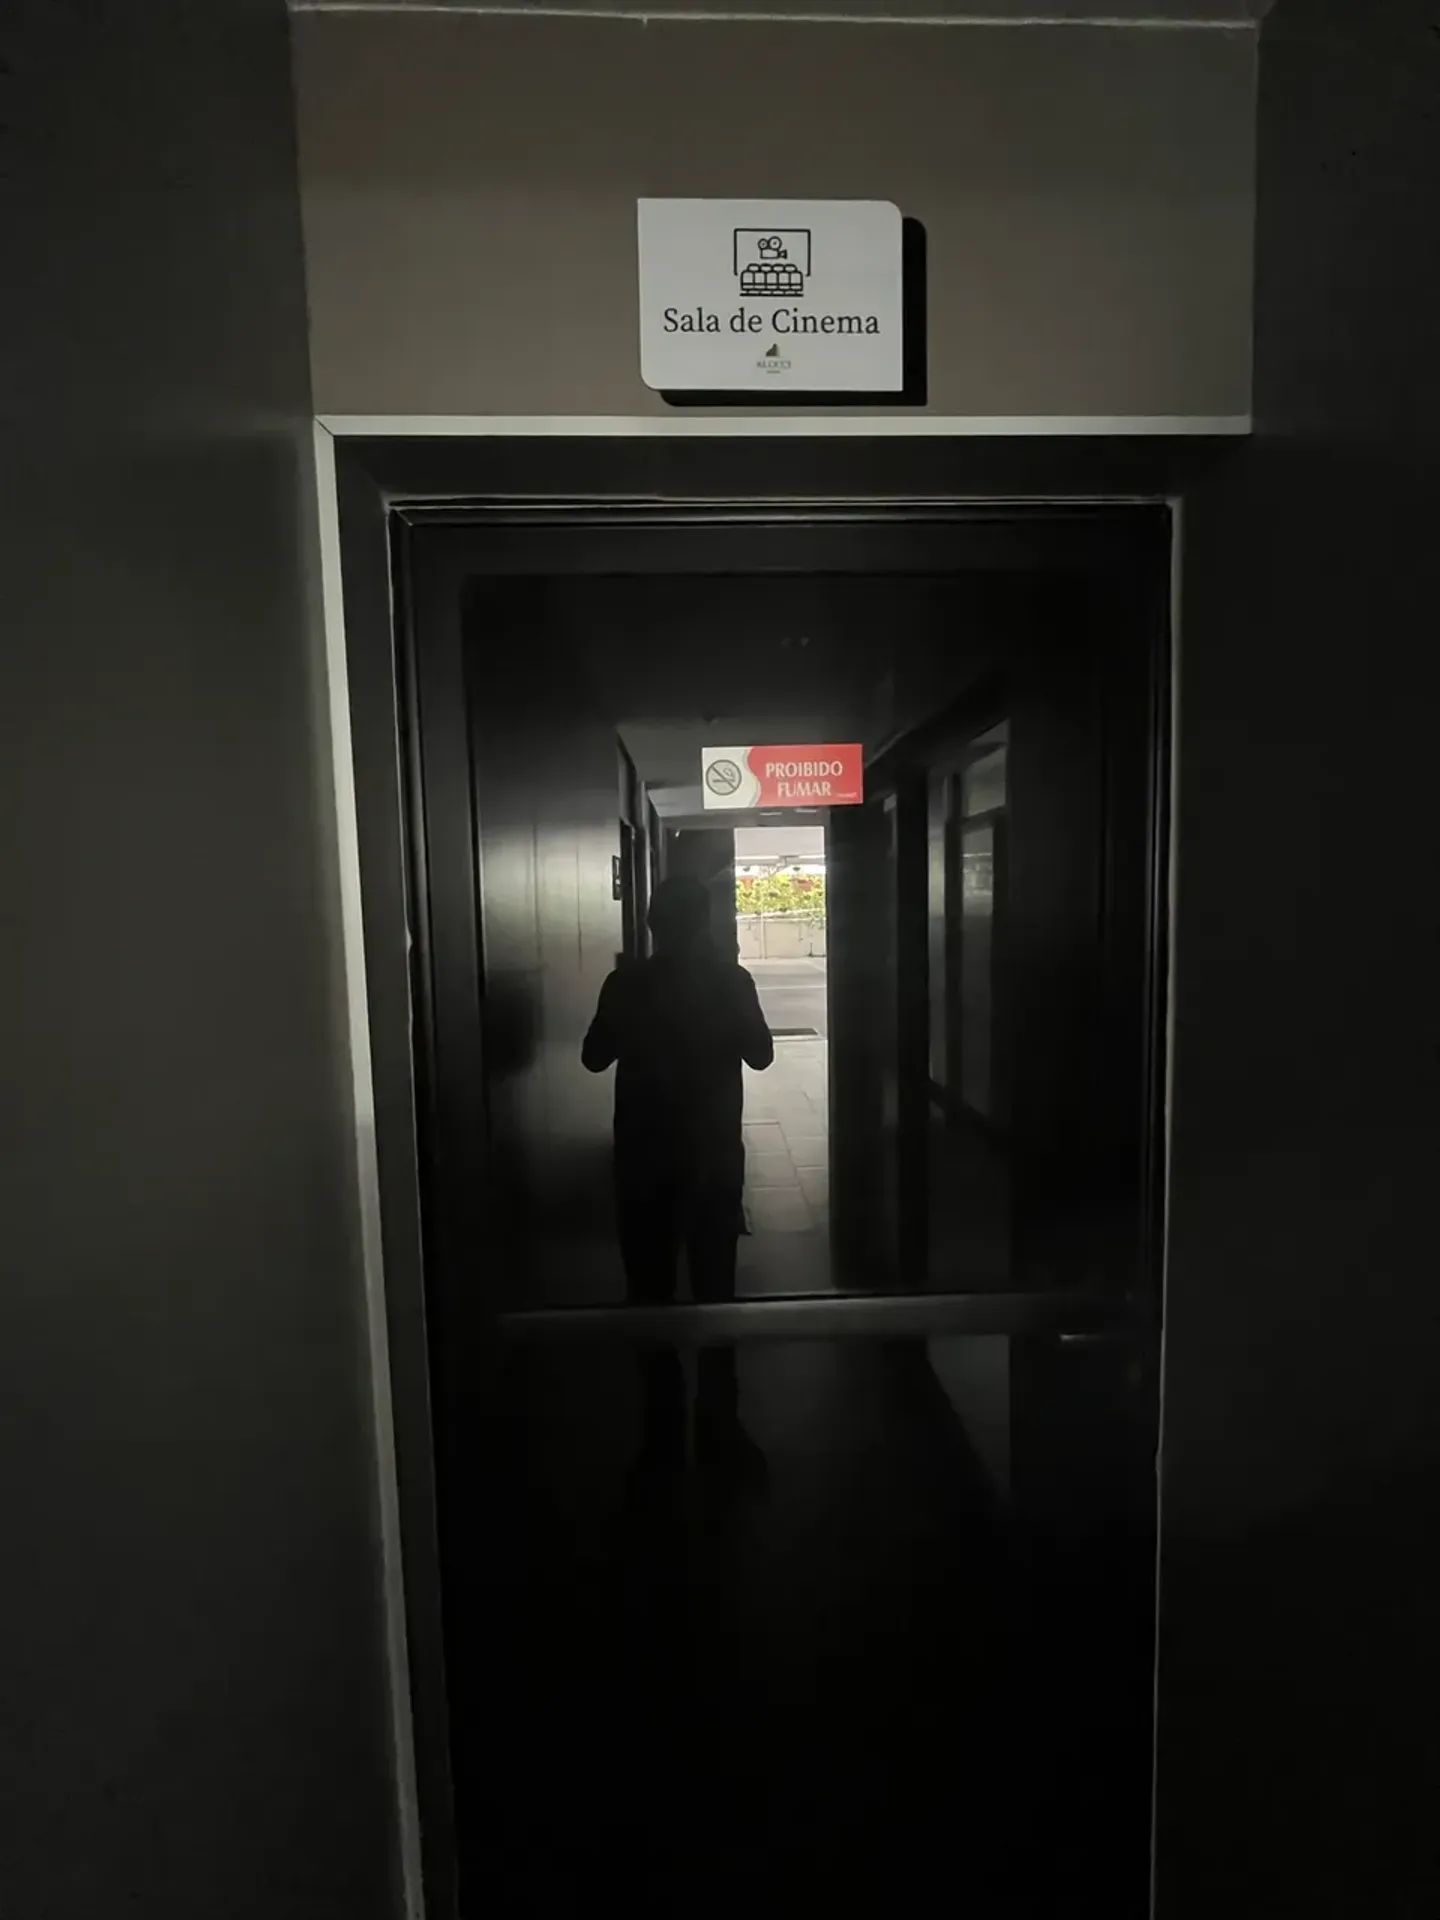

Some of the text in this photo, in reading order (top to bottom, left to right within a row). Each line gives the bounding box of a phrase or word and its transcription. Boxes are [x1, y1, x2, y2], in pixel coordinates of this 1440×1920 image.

[664, 307, 880, 334] Sala de Cinema
[765, 761, 843, 778] PROIBIDO
[777, 782, 832, 798] FUMAR
